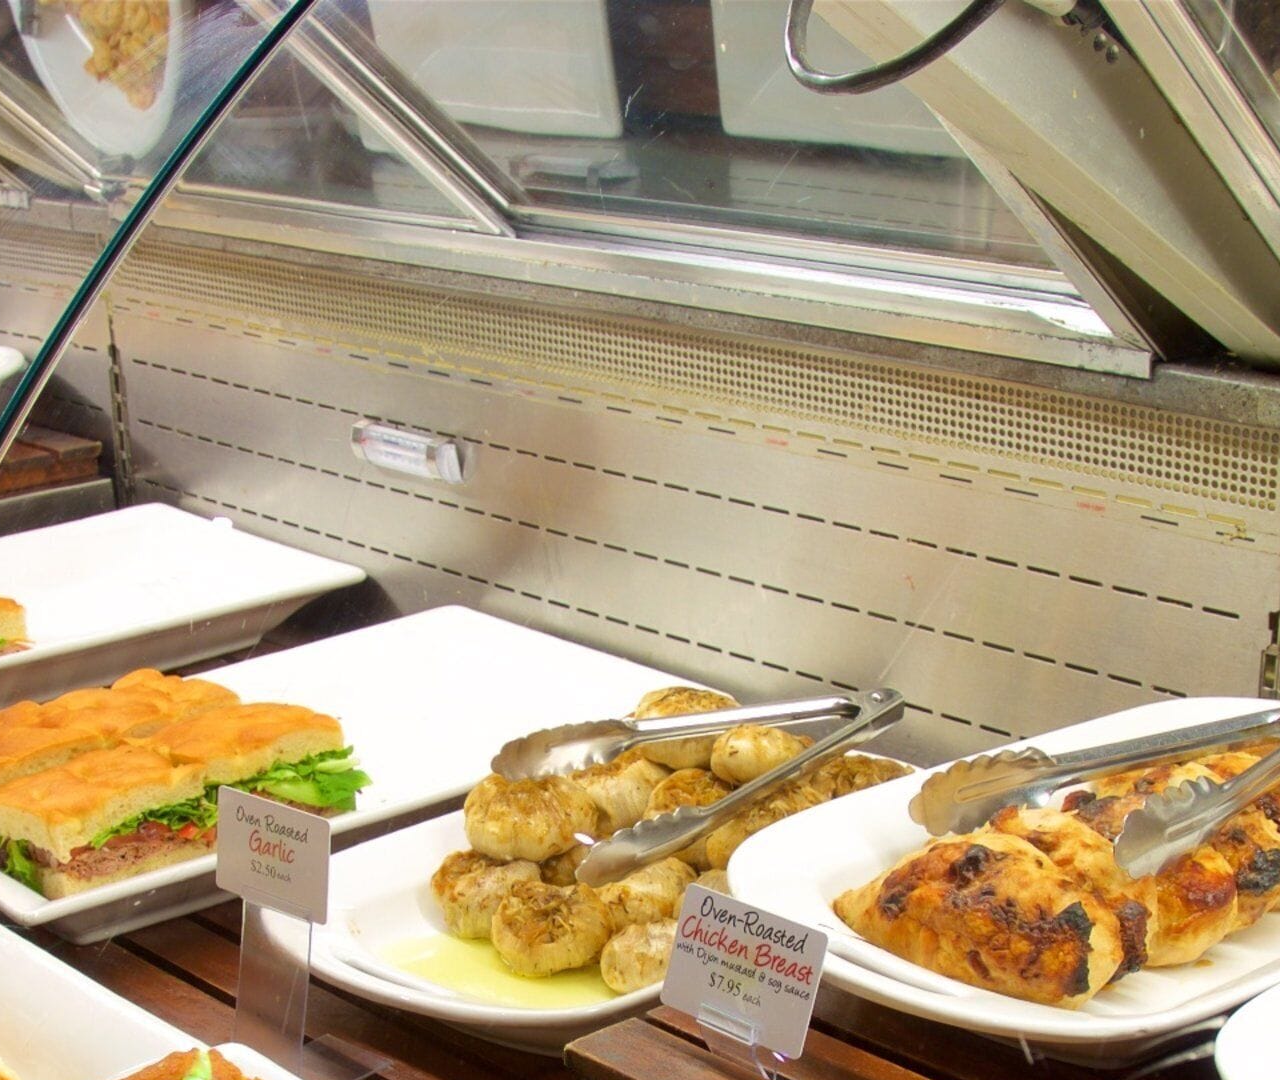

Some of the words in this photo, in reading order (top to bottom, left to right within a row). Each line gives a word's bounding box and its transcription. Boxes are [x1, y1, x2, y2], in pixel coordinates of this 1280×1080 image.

[236, 805, 261, 828] Oven
[264, 814, 308, 843] Roasted
[249, 830, 295, 864] Garlic
[700, 896, 808, 954] Oven-Roasted
[677, 942, 694, 955] with
[696, 947, 718, 965] Dijon
[768, 978, 782, 994] soy
[784, 984, 811, 1001] sauce
[681, 915, 749, 960] Chicken
[754, 943, 813, 985] Breast
[709, 971, 741, 997] $7.95
[742, 993, 761, 1007] each
